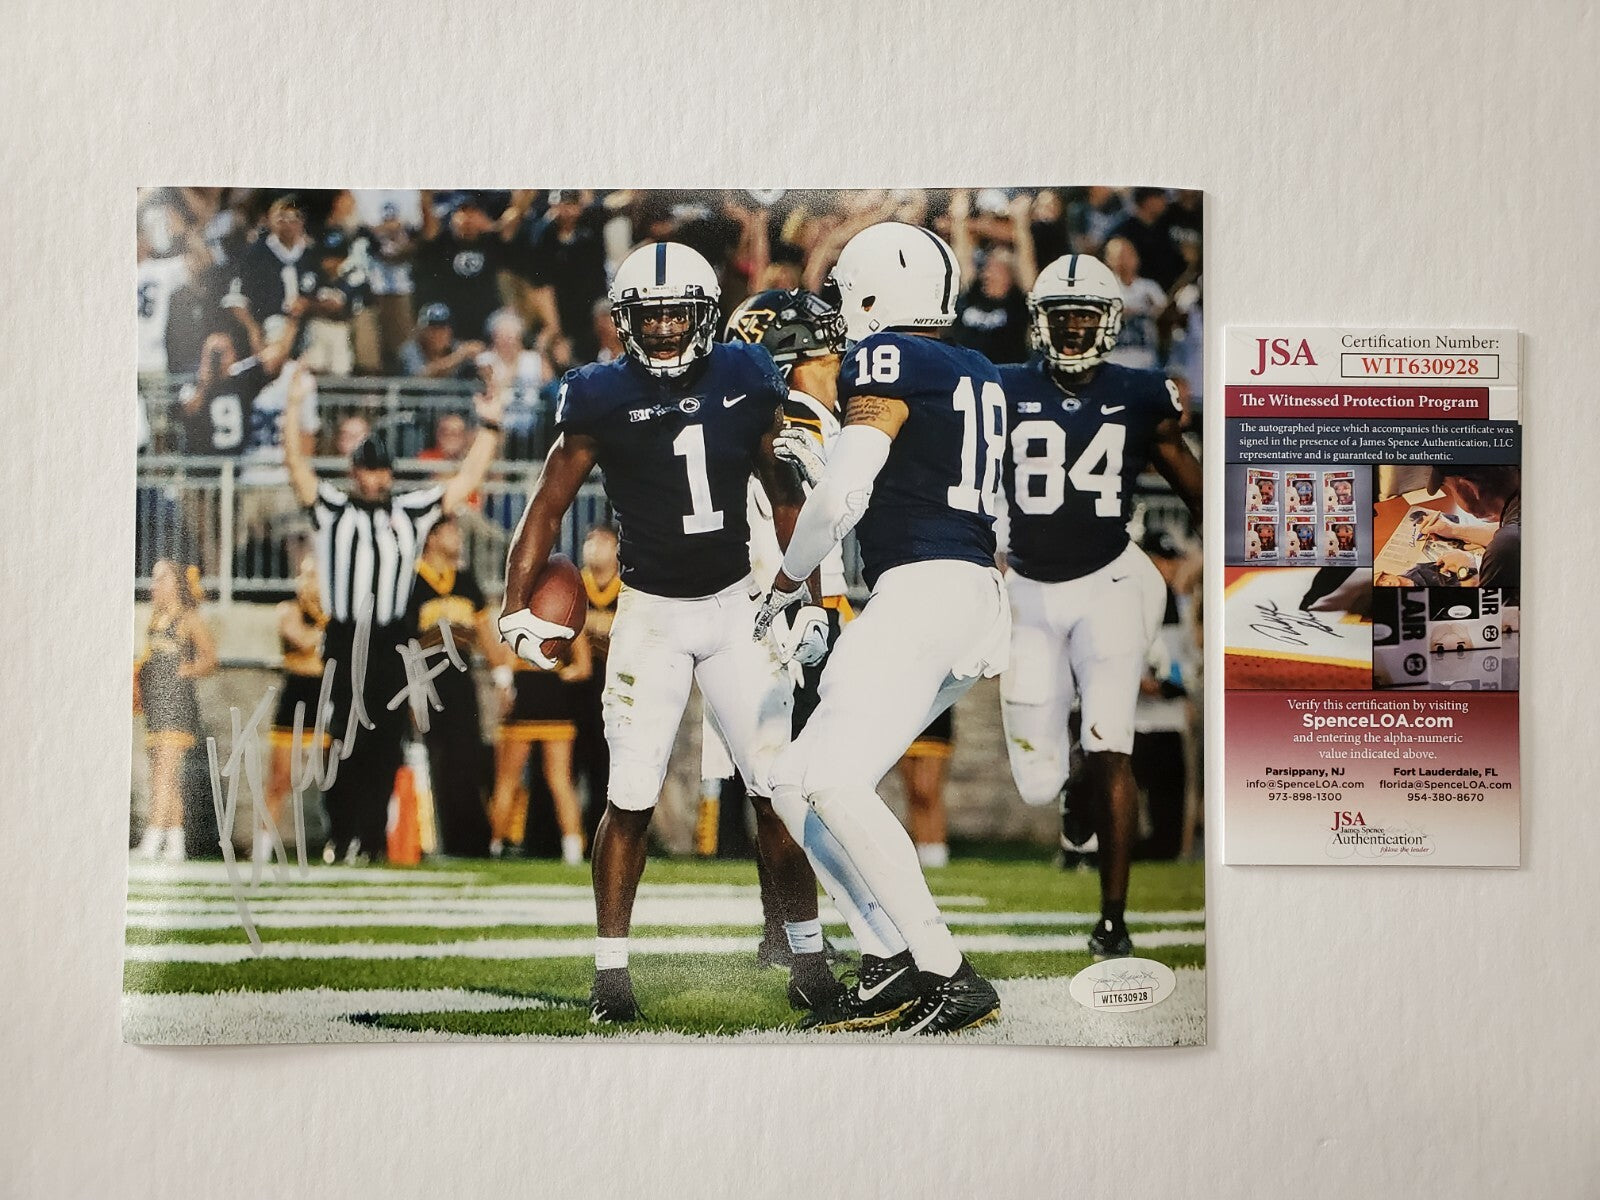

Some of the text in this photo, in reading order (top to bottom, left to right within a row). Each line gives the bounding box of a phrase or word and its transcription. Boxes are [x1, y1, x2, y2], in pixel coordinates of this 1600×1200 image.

[1341, 334, 1499, 349] Certification Number:
[1250, 338, 1317, 376] JSA
[855, 345, 900, 386] 18
[1361, 358, 1479, 375] WIT630928
[1239, 393, 1479, 410] The Witnessed Protection Program
[1239, 422, 1256, 431] The
[1259, 423, 1315, 435] autographed
[1317, 424, 1340, 435] piece
[1342, 423, 1369, 433] which
[1372, 424, 1429, 435] accompanies
[1432, 424, 1448, 433] this
[1451, 424, 1494, 434] certificate
[947, 376, 1007, 519] 18
[1240, 436, 1269, 448] signed
[1271, 436, 1280, 445] in
[1282, 436, 1297, 445] the
[1299, 438, 1338, 448] presence
[1340, 436, 1351, 445] of
[1359, 437, 1385, 447] James
[1388, 437, 1419, 448] Spence
[1421, 437, 1491, 448] Authentication,
[1494, 438, 1513, 447] LLC
[1239, 450, 1453, 462] representative and is guaranteed to be authentic.
[1010, 420, 1126, 518] 84
[673, 424, 724, 534] 1
[1484, 628, 1498, 639] 63
[1288, 699, 1469, 713] Verify this certification by visiting
[1303, 713, 1453, 730] SpenceLOA.com
[1293, 731, 1463, 745] and entering the alpha-numeric
[1318, 748, 1437, 760] value indicated above.
[1265, 767, 1345, 778] Parsippany, NJ
[1393, 767, 1498, 778] Fort Lauderdale, FL
[1246, 779, 1364, 790] info@SpenceLOA.com
[1380, 779, 1512, 790] florida@SpenceLOA.com
[1268, 792, 1342, 801] 973-898-1300
[1407, 793, 1484, 802] 954-380-8670
[1331, 811, 1366, 831] JSA
[1101, 991, 1148, 1004] WIT630928
